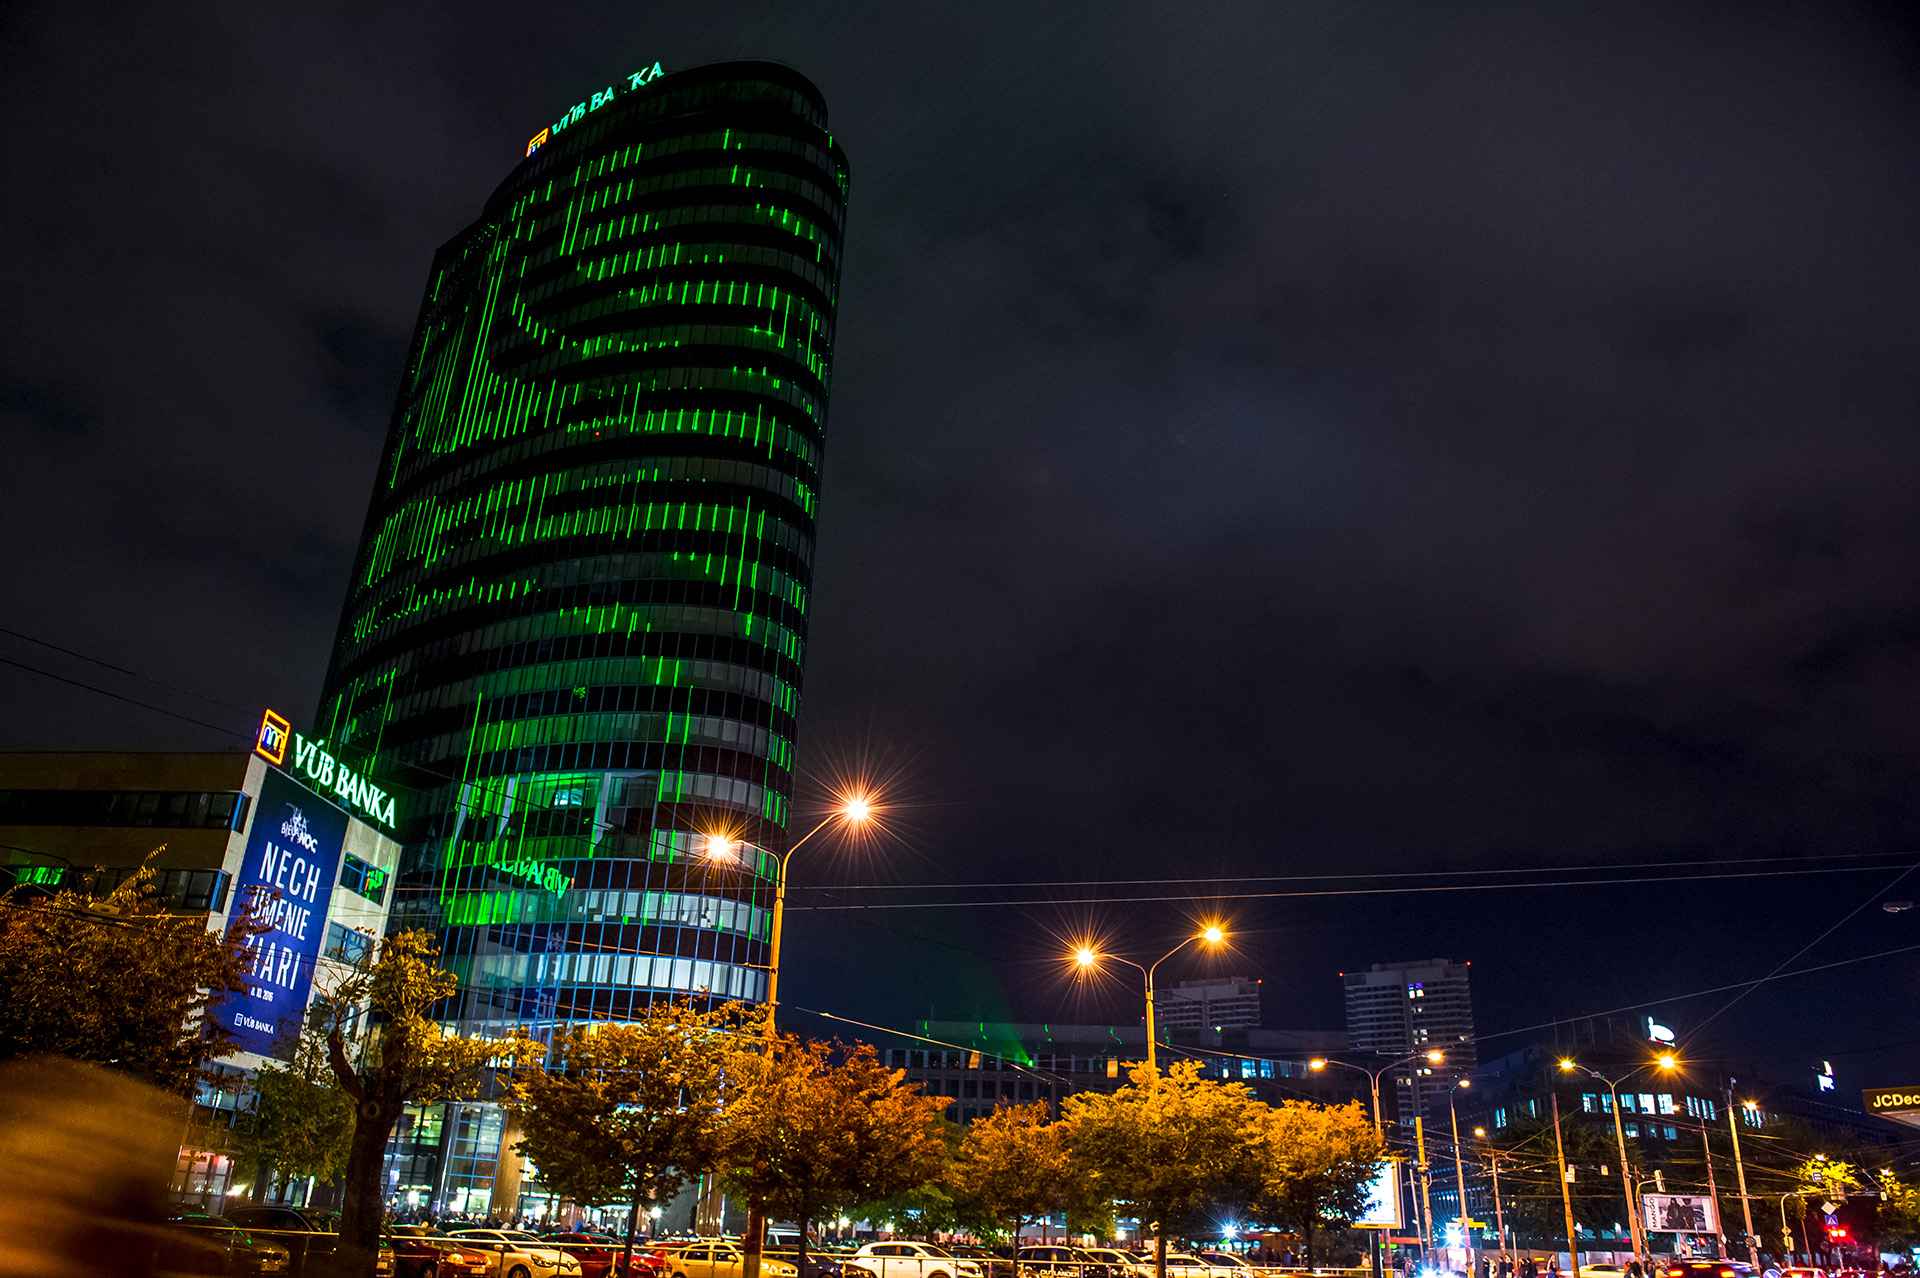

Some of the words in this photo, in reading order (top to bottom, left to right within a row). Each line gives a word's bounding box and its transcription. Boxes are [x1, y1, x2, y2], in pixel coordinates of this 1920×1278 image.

[589, 61, 664, 112] BAKA
[295, 733, 335, 787] VÚB
[334, 763, 396, 829] BANKA
[259, 841, 321, 904] NECH
[255, 1020, 274, 1034] BANKA
